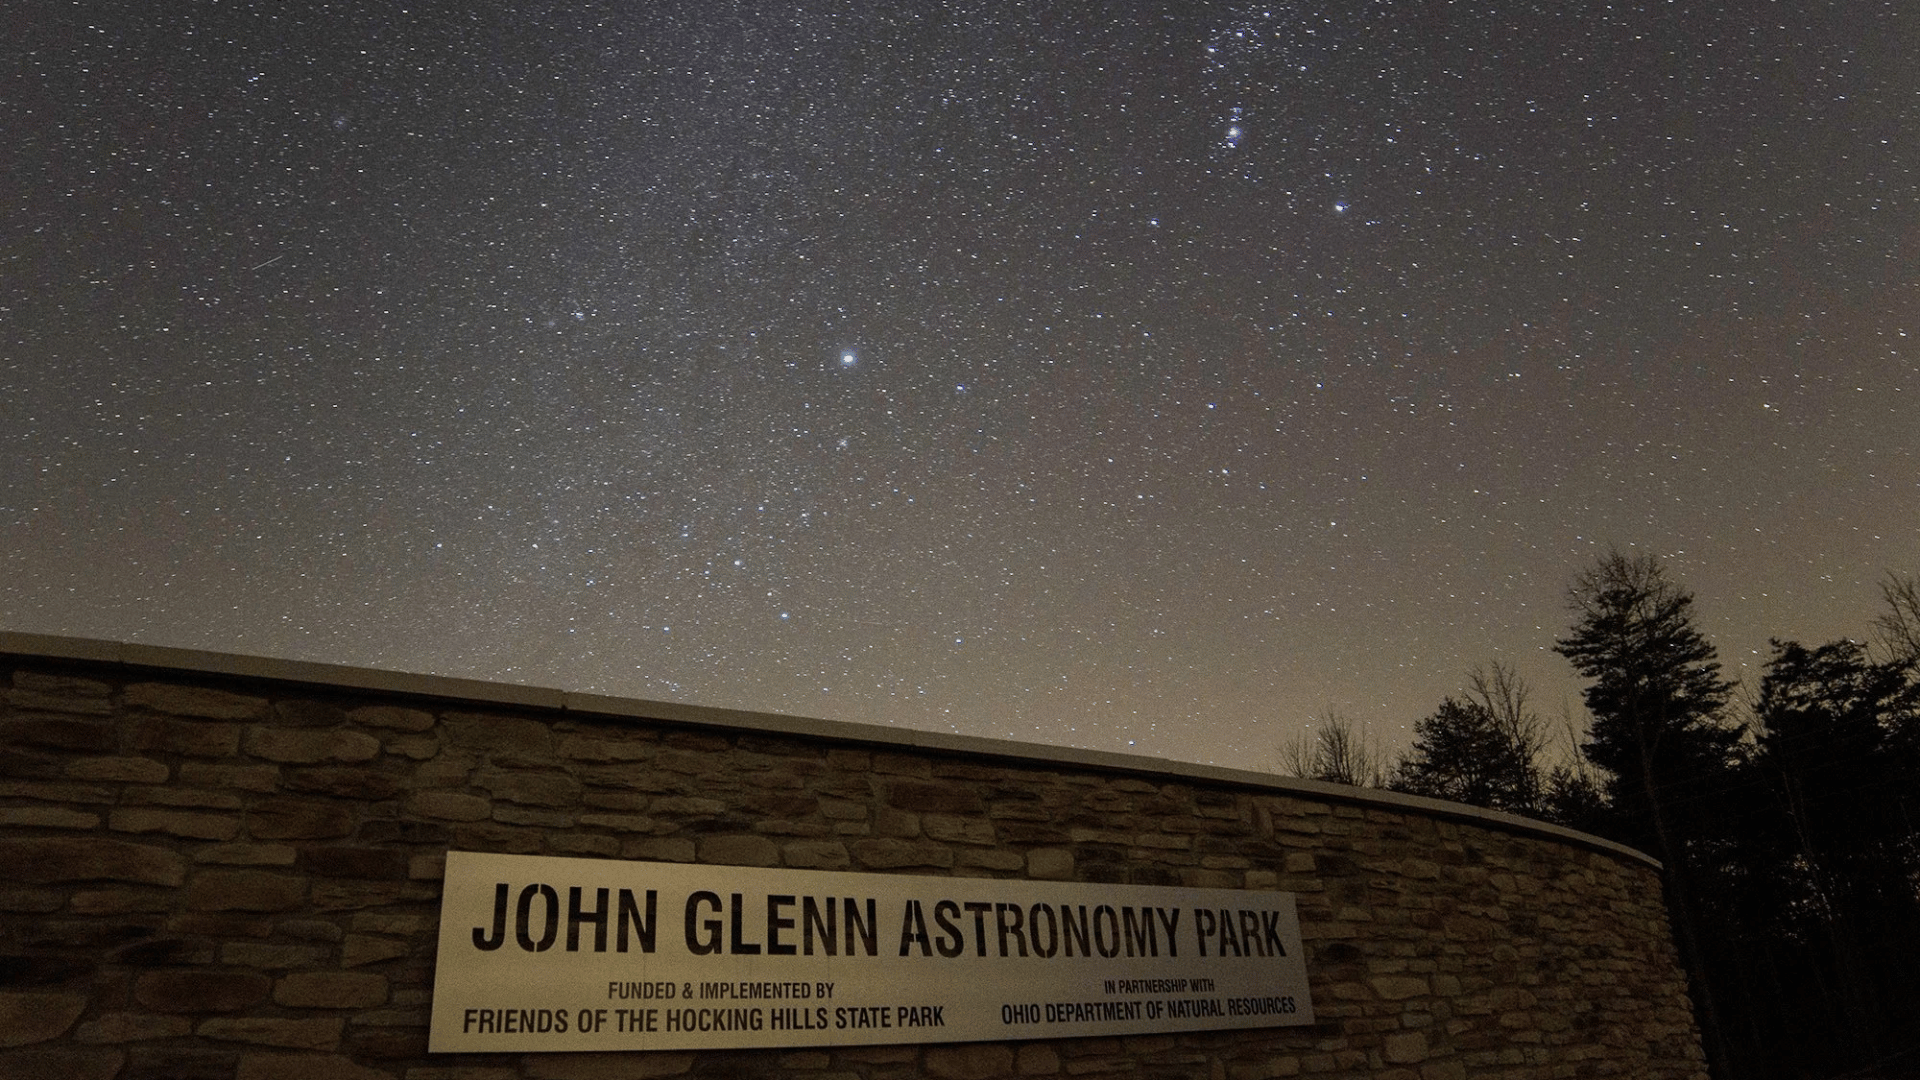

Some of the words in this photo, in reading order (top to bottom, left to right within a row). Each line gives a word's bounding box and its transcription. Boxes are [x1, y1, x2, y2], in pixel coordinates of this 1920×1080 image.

[471, 883, 658, 953] JOHN
[684, 890, 878, 957] GLENN
[899, 899, 1180, 959] ASTRONOMY
[1195, 908, 1287, 958] PARK
[608, 981, 676, 999] FUNDED
[681, 982, 694, 1000] &
[700, 981, 811, 999] IMPLEMENTED
[816, 982, 835, 999] BY
[1105, 979, 1115, 994] IN
[1119, 978, 1187, 994] PARTNERSHIP
[1191, 978, 1215, 993] WITH
[463, 1009, 569, 1034] FRIENDS
[577, 1009, 608, 1033] OF
[615, 1008, 658, 1032] THE
[666, 1008, 763, 1032] HOCKING
[771, 1007, 828, 1031] HILLS
[835, 1006, 891, 1029] STATE
[898, 1005, 945, 1028] PARK
[1002, 1003, 1041, 1025] OHIO
[1046, 1001, 1141, 1024] DEPARTMENT
[1146, 1001, 1165, 1020] OF
[1167, 998, 1225, 1019] NATURAL
[1228, 996, 1296, 1016] RESOURCES
